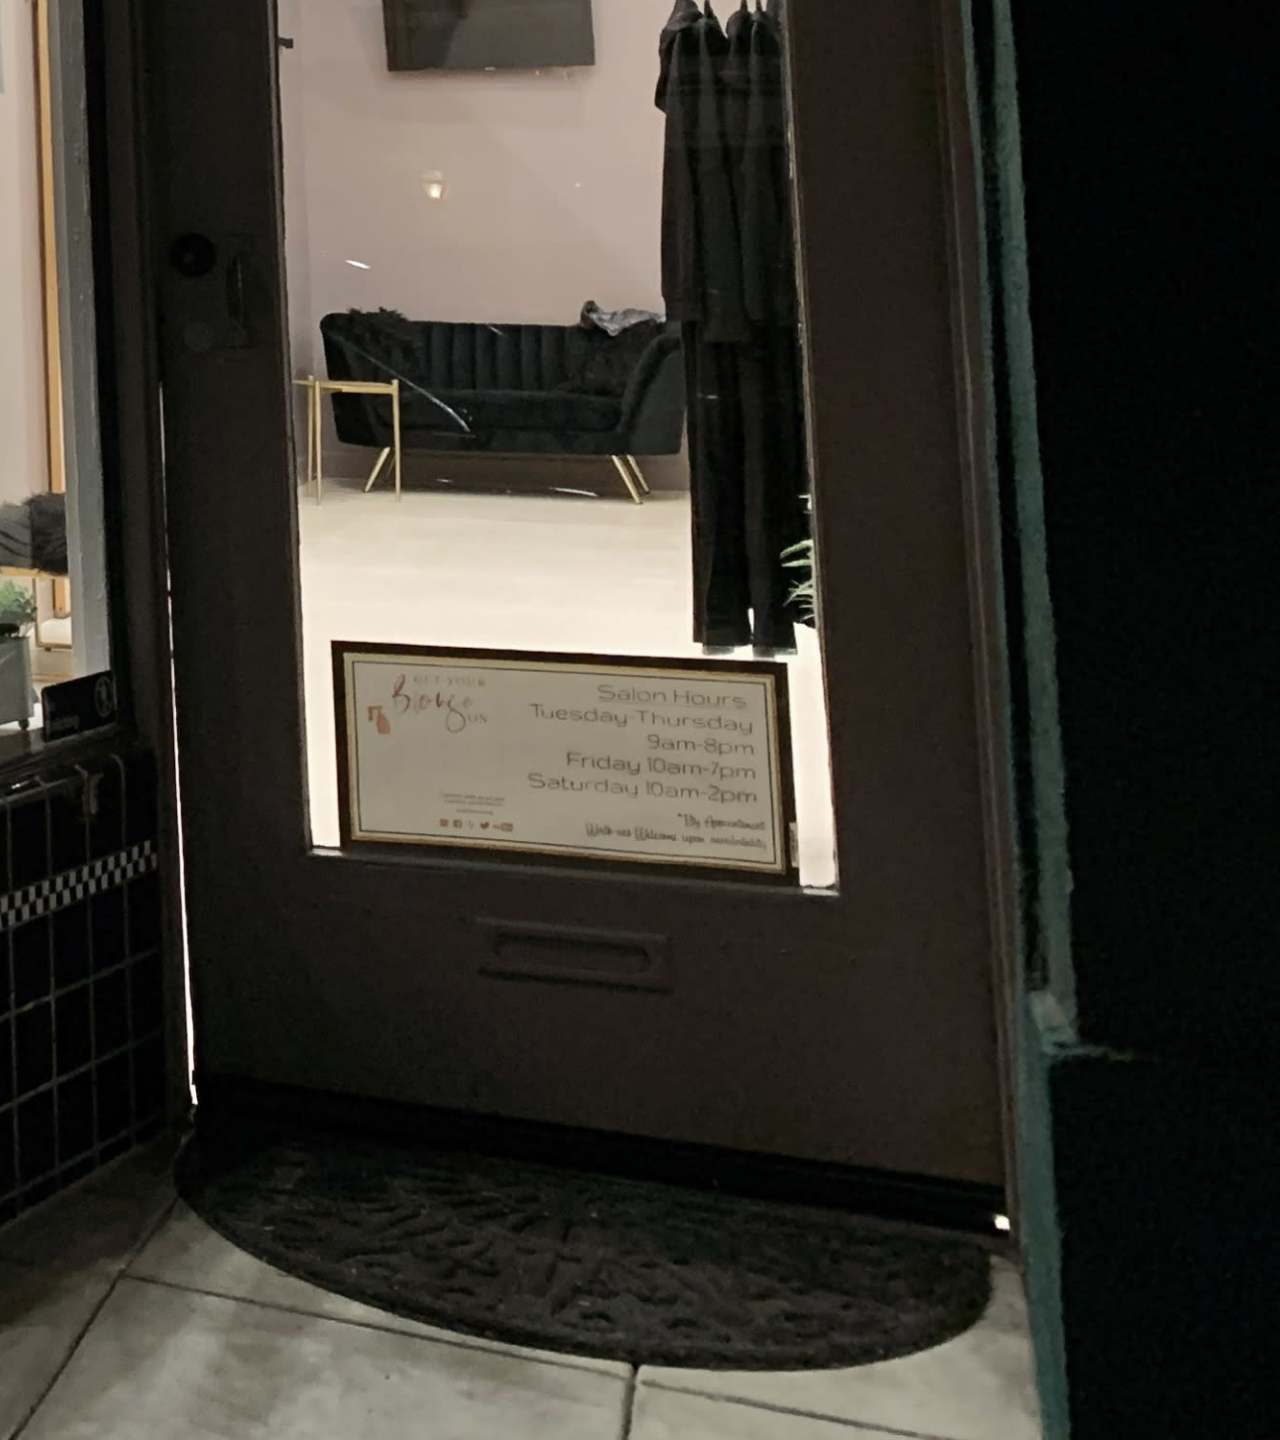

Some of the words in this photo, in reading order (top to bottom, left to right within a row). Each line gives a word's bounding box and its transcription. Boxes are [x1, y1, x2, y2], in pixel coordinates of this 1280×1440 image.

[597, 683, 667, 704] Salon
[672, 688, 748, 710] Hours
[646, 733, 755, 757] 9am-8pm
[566, 751, 641, 777] Friday
[647, 757, 757, 781] 10am-7pm
[527, 772, 639, 800] Saturday
[645, 780, 758, 805] 10am-2pm
